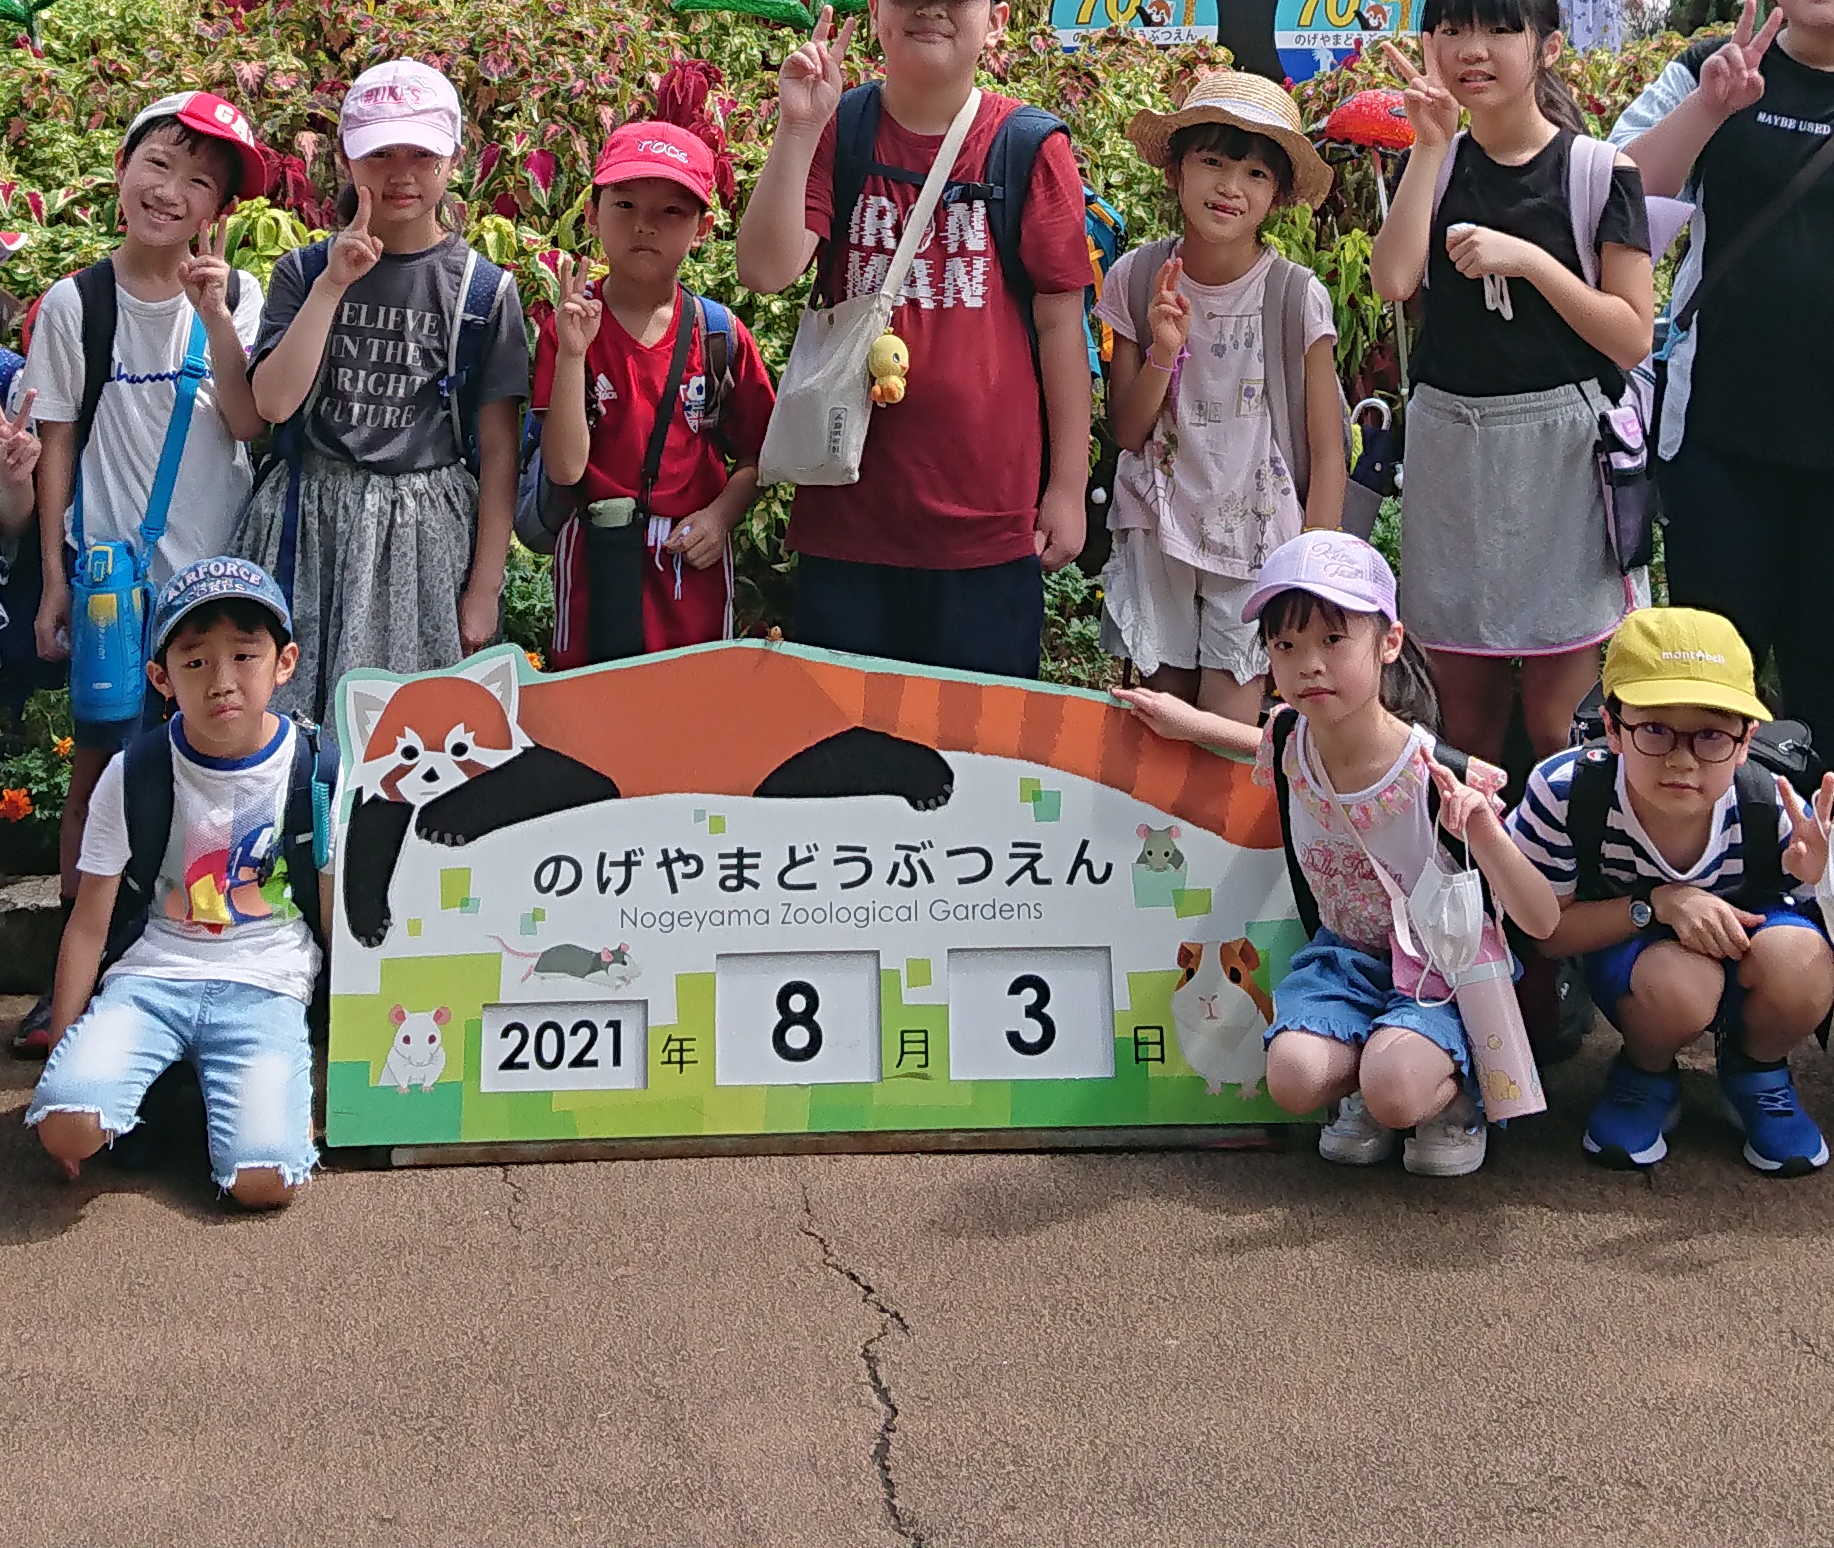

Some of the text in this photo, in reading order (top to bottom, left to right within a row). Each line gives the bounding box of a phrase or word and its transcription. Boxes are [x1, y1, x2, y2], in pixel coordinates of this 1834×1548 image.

[1756, 111, 1797, 130] MAYBE
[1798, 120, 1831, 136] USED
[340, 301, 441, 337] ELIEVE
[366, 337, 424, 367] THE
[330, 366, 428, 398] RIGHT
[320, 396, 416, 429] FUTURE
[532, 837, 1114, 899] のげやまどうぶつえん
[619, 897, 1044, 934] Nogeyama Zoological Gardens
[498, 973, 1166, 1075] 2021 年 8 月 3 日
